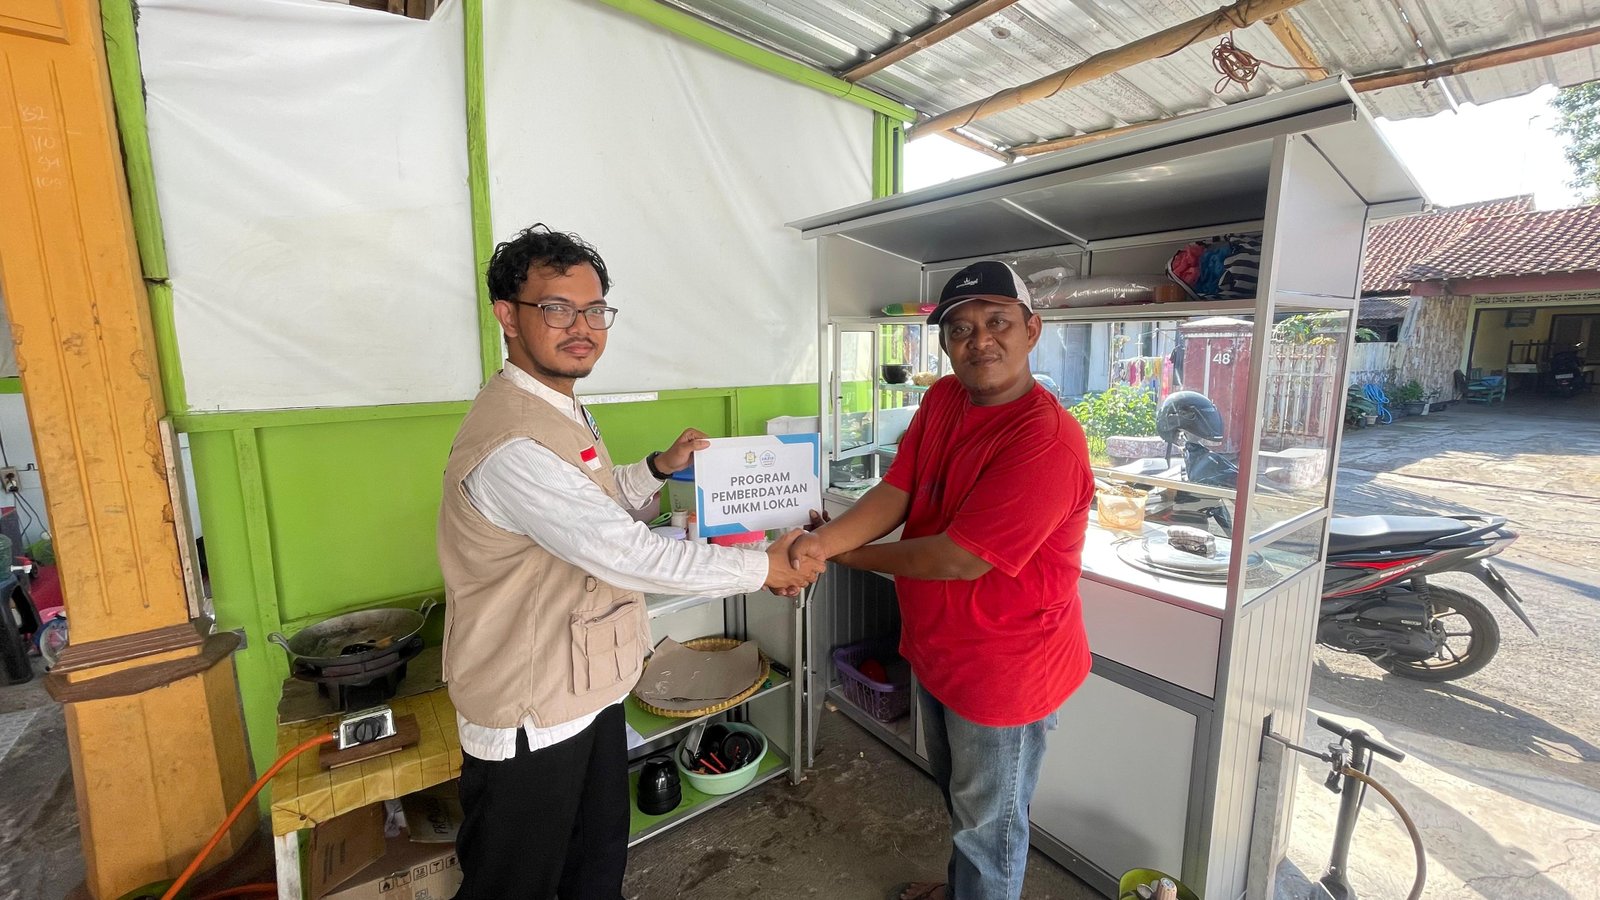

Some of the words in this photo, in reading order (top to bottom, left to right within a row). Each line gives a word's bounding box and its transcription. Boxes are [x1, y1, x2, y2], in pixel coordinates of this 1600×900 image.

[1212, 353, 1231, 365] 48
[730, 472, 791, 487] PROGRAM
[711, 483, 808, 503] PEMBERDAYAAN
[722, 501, 761, 515] UMKM
[763, 497, 799, 511] LOKAL
